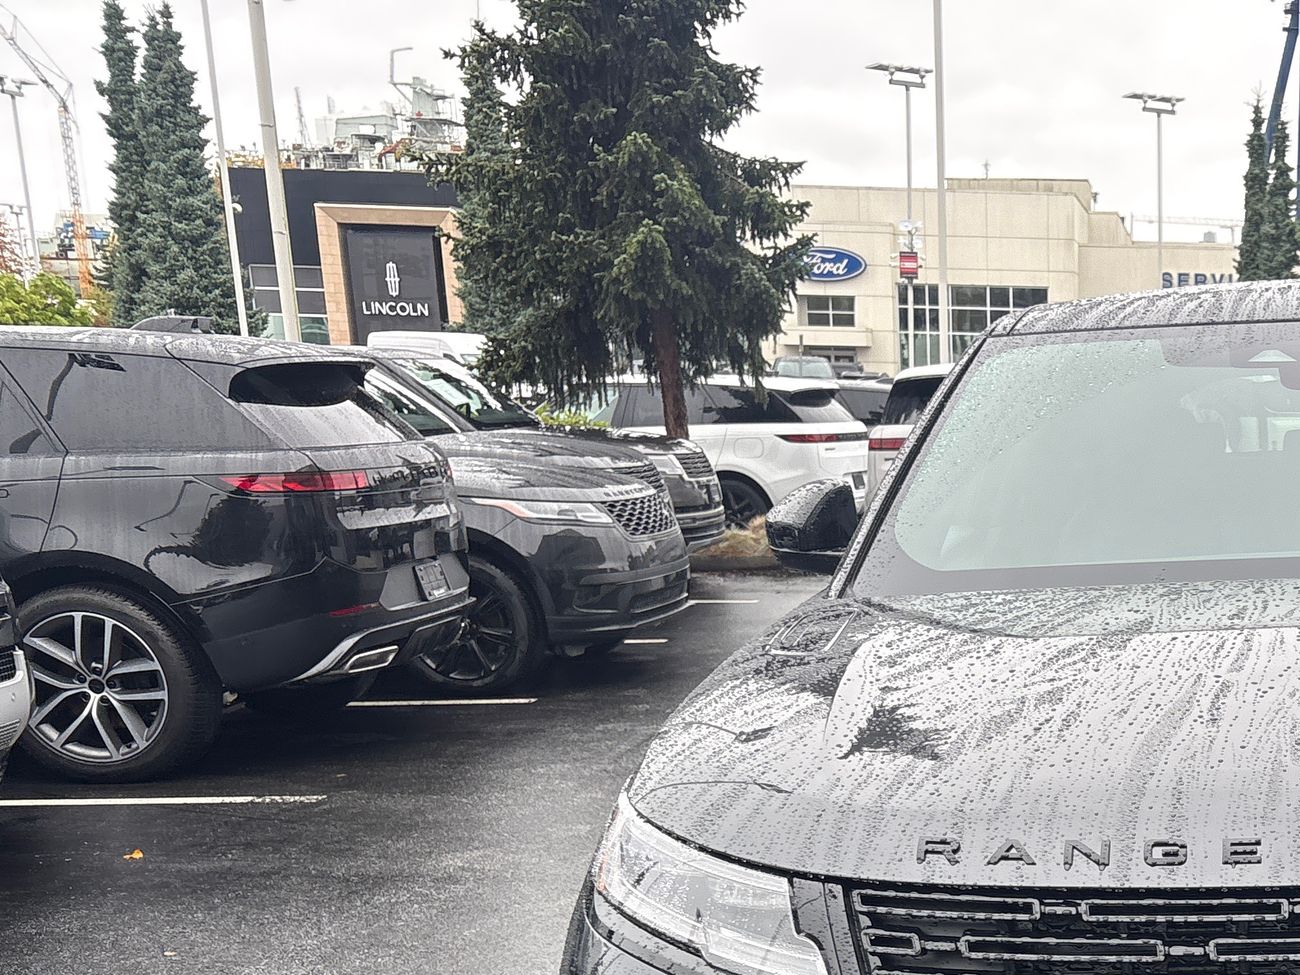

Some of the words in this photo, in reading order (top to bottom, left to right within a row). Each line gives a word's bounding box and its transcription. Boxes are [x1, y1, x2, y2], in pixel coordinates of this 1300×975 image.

[802, 252, 849, 275] Ford
[362, 301, 429, 316] LINCOLN
[916, 837, 1262, 869] RANGE
